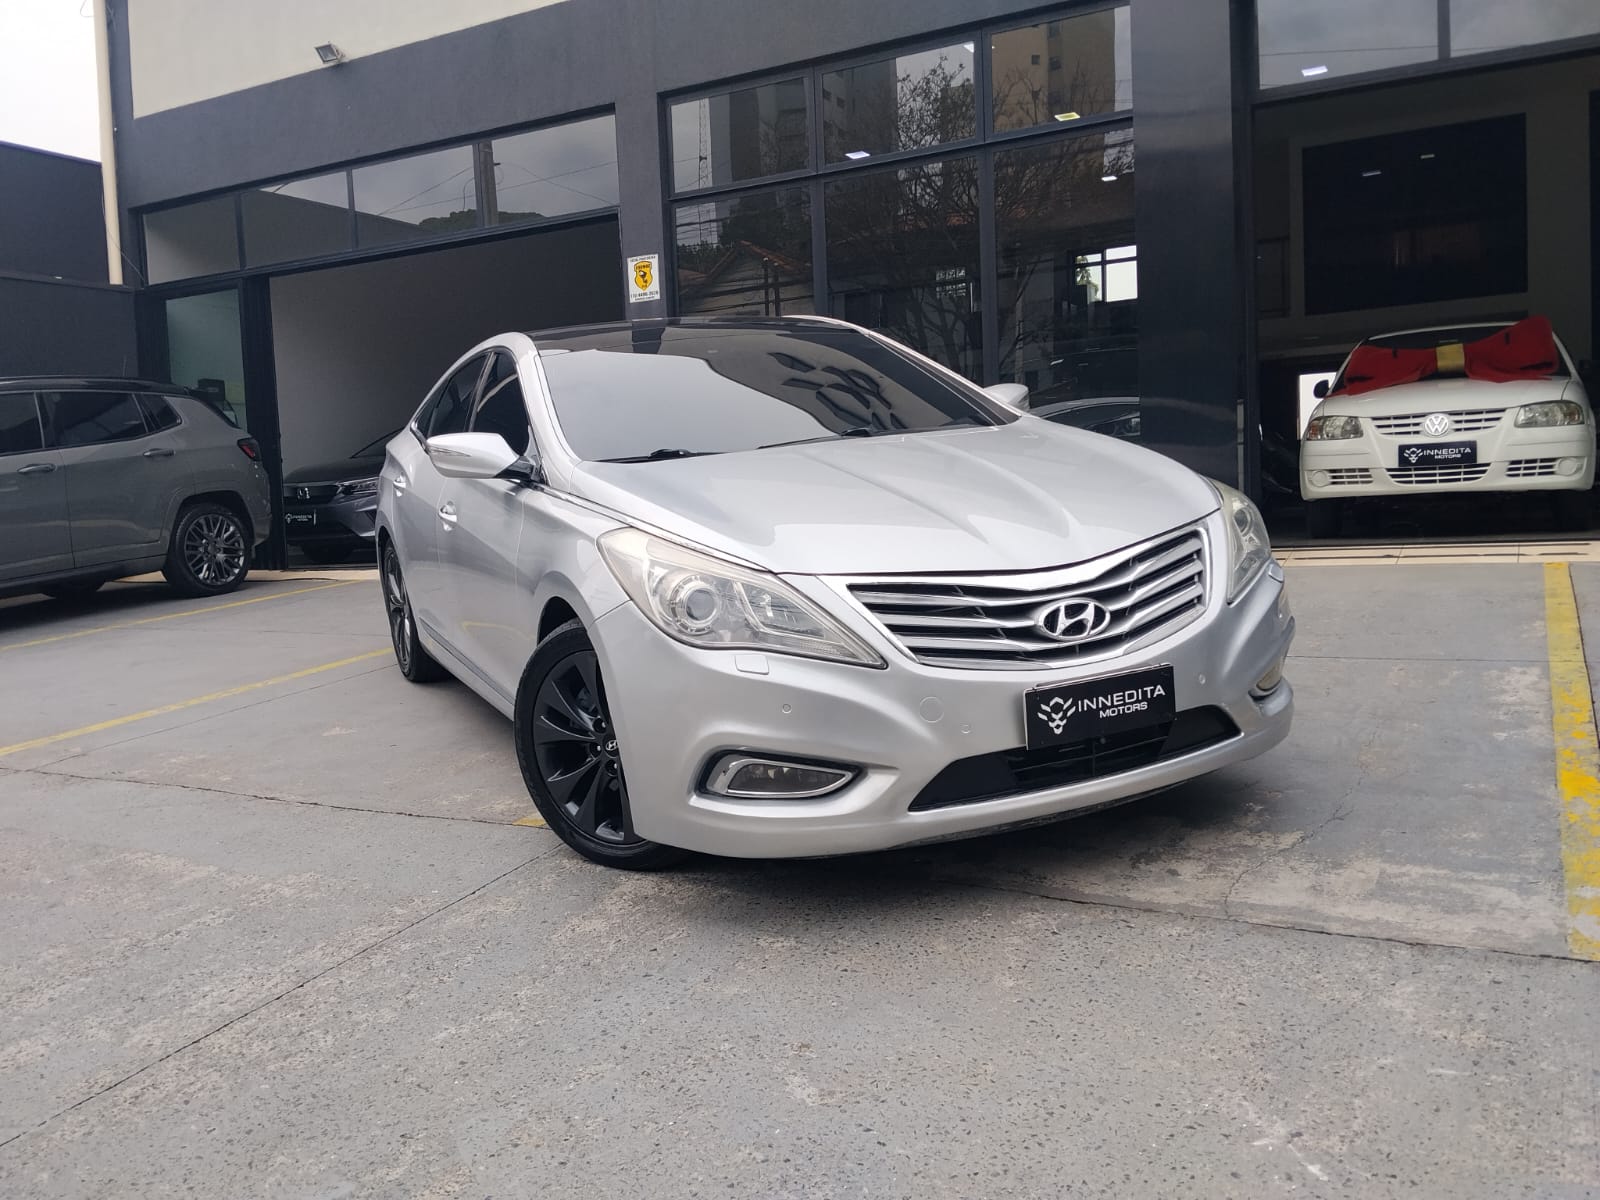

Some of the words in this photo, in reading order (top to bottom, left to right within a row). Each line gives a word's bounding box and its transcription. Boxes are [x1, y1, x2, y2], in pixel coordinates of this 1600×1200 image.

[1423, 447, 1472, 456] INNEDITA
[1078, 684, 1166, 712] INNEDITA
[1099, 701, 1148, 719] MOTORS
